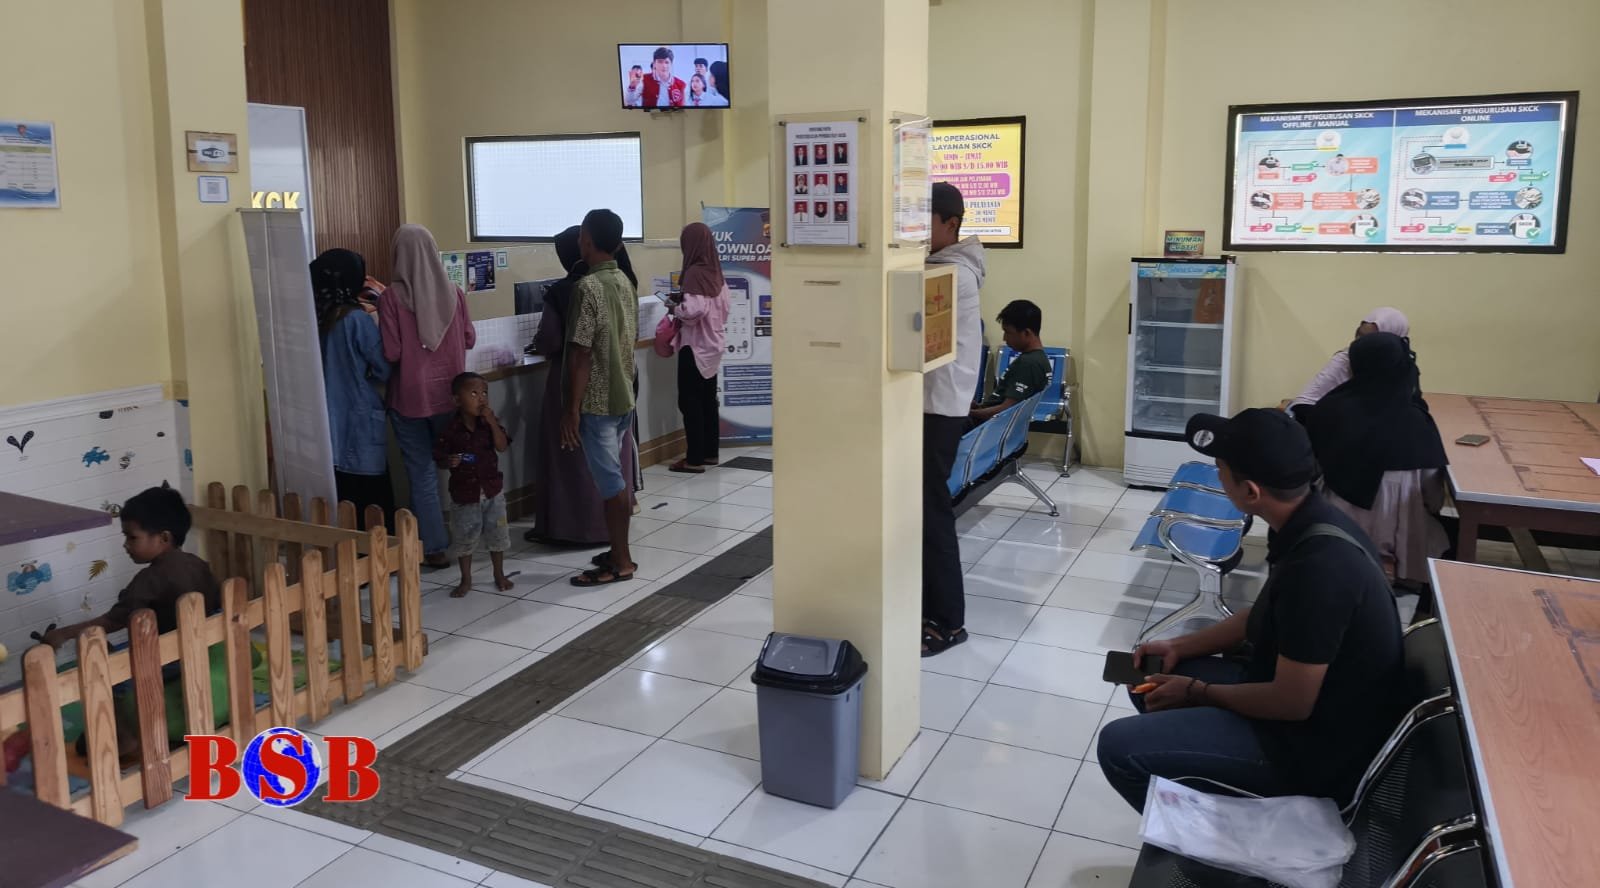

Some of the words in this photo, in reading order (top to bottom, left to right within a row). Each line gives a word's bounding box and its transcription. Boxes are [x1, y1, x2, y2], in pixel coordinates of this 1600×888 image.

[1415, 109, 1461, 117] MEKANISME
[1462, 106, 1517, 115] PENGURUSAN
[1260, 114, 1302, 122] MEKANISME
[1304, 112, 1353, 121] PENGURUSAN
[1282, 121, 1312, 129] OFFLINE
[943, 134, 1000, 142] OPERASIONAL
[972, 142, 993, 150] SKCK
[996, 160, 1008, 168] WIB
[716, 243, 771, 254] OWNLOA
